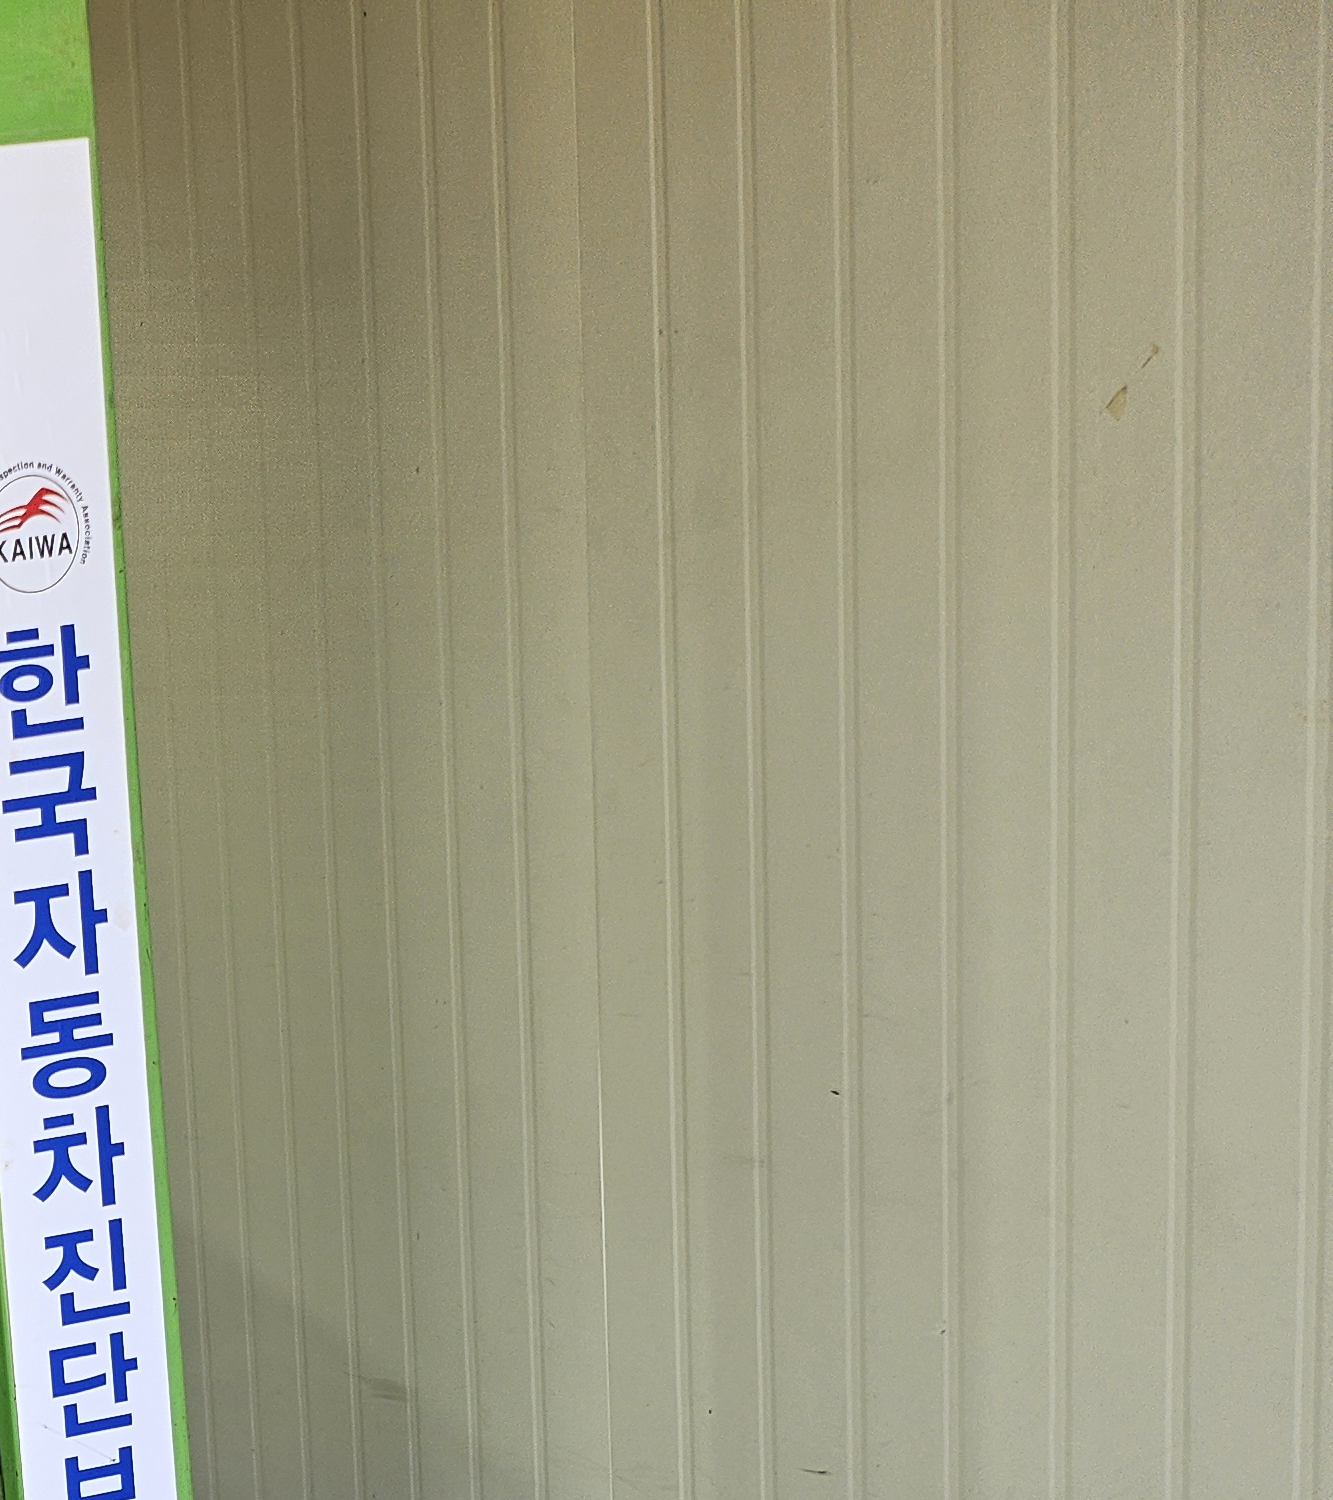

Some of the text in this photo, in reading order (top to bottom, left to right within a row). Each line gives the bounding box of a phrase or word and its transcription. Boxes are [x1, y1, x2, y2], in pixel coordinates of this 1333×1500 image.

[37, 461, 53, 472] and
[54, 465, 85, 503] Warranty
[80, 505, 93, 565] Association
